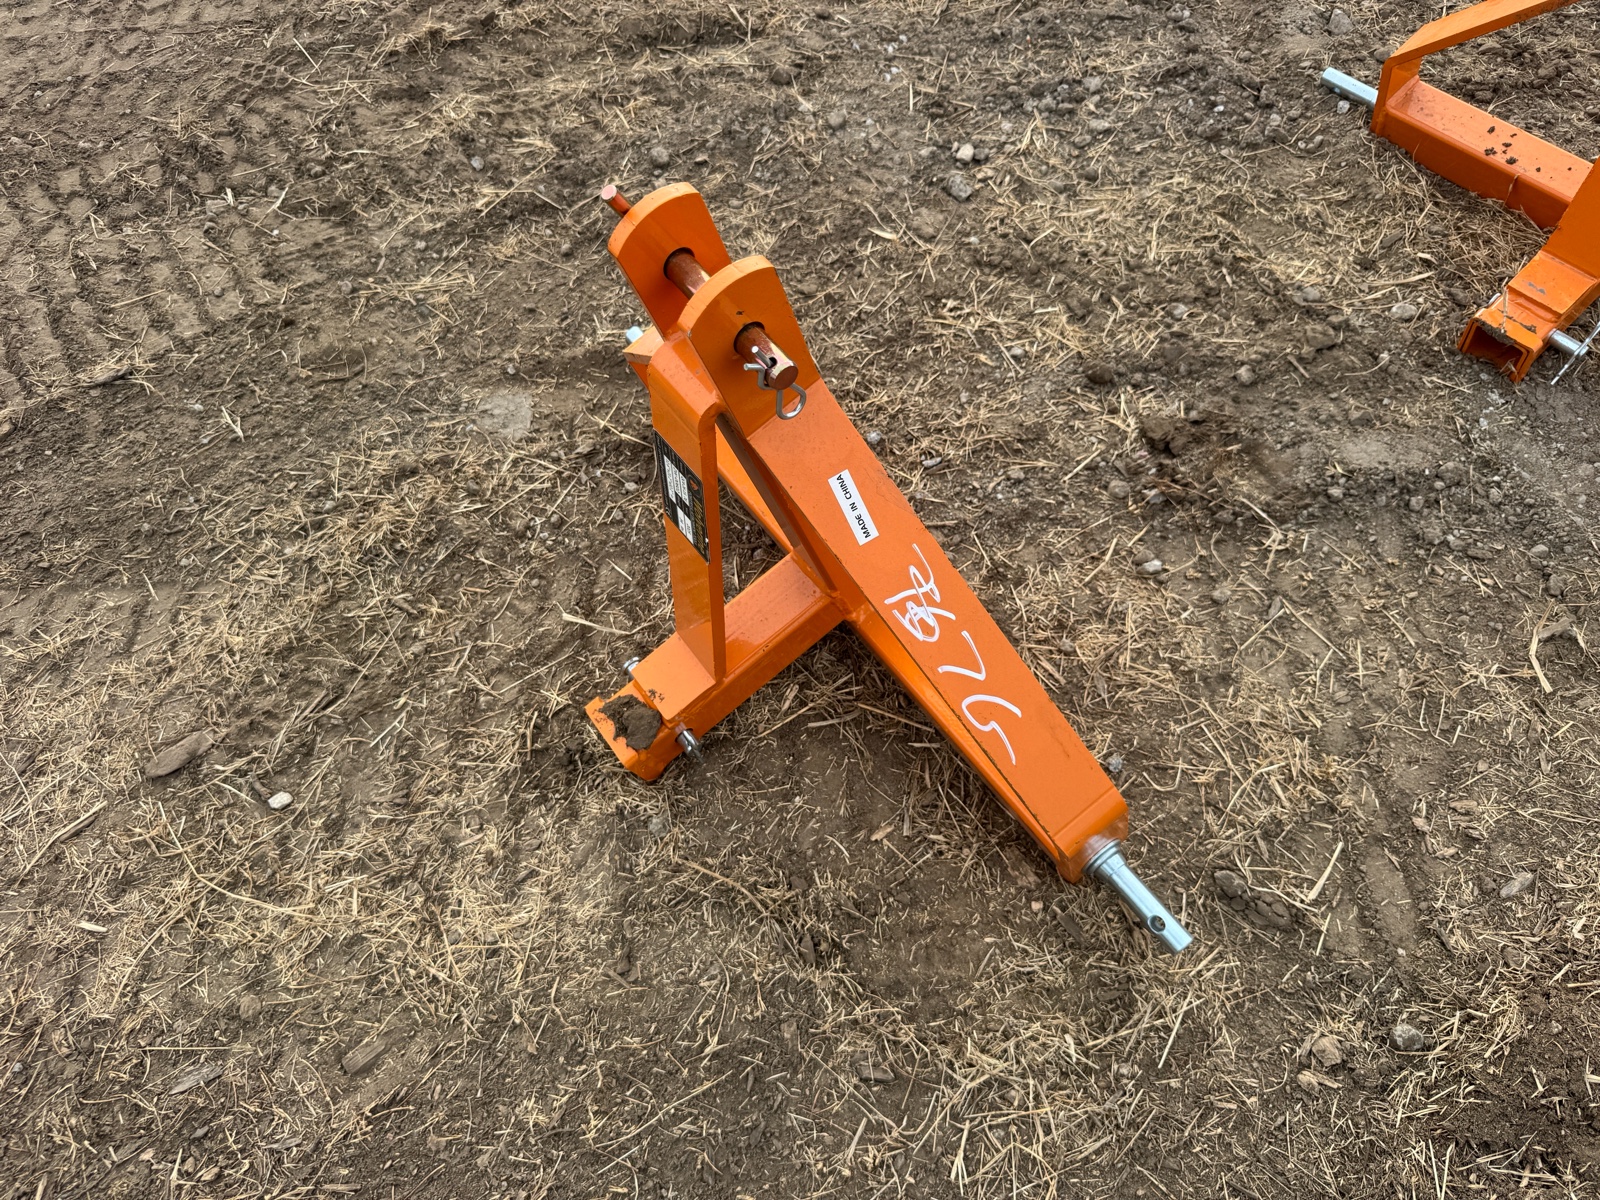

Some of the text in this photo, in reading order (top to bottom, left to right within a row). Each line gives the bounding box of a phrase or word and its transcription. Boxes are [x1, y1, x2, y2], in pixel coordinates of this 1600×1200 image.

[836, 474, 871, 538] MADE IN CHINA
